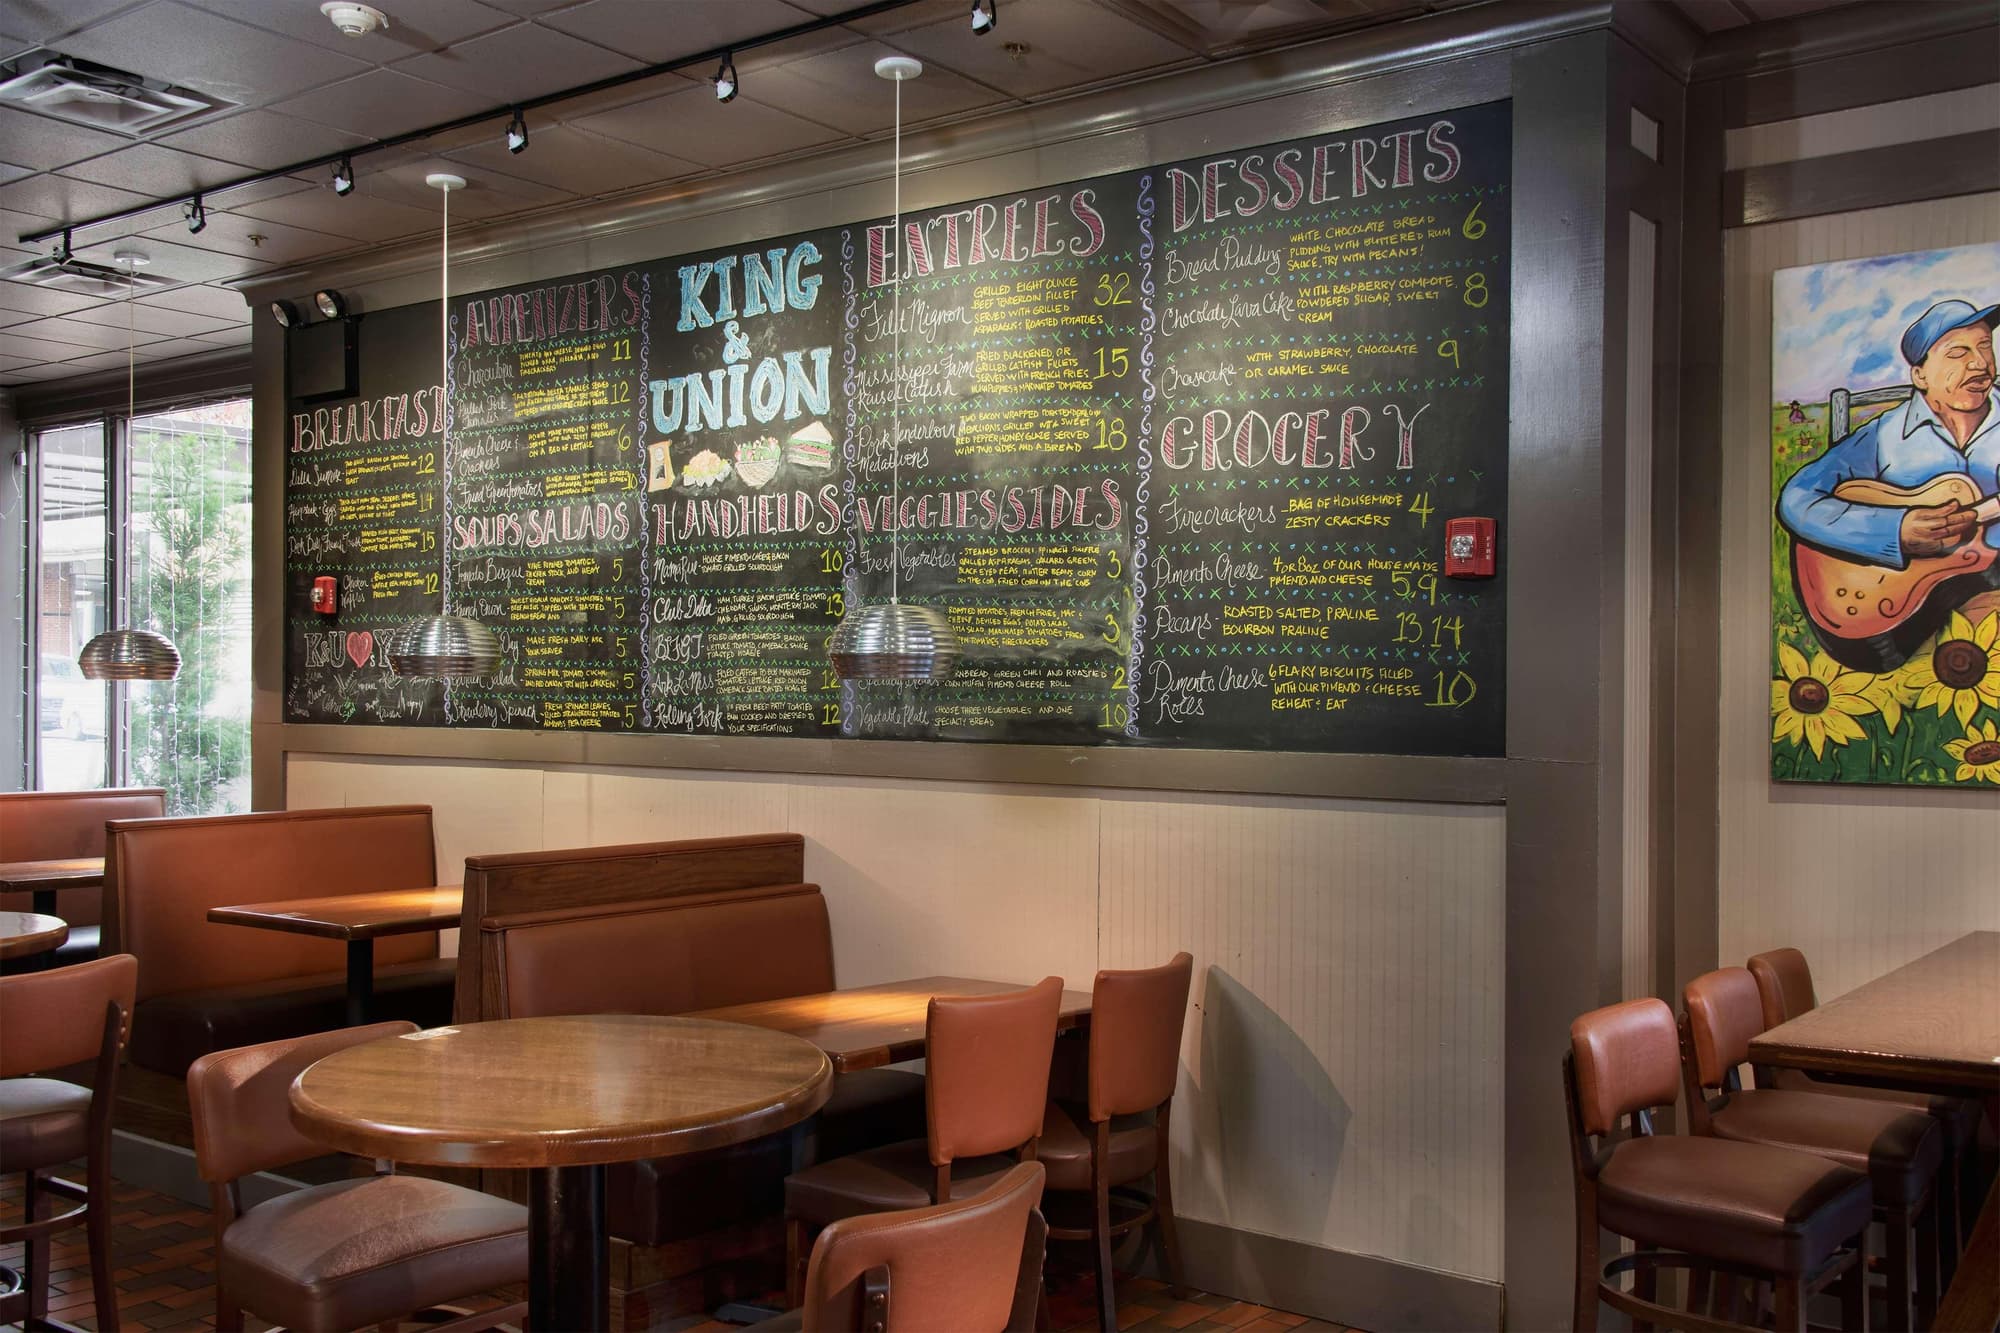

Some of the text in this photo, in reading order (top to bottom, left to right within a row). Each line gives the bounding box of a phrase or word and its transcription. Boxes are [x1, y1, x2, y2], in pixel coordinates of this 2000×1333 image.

[1166, 120, 1461, 233] DESSERTS
[1289, 215, 1436, 244] WHITE CHOCOLATE BREAD
[1462, 201, 1487, 240] 6
[865, 189, 1106, 288] ENTREES
[1289, 227, 1451, 259] PUDDING WITH RUM
[1164, 235, 1282, 286] Bread Pudding
[1322, 252, 1366, 267] TRY WITH
[676, 240, 823, 332] KING
[973, 278, 1046, 299] GRILLED EIGHT
[1045, 289, 1078, 301] FILLET
[1093, 272, 1133, 307] 32
[1298, 279, 1396, 298] WITH RASPBERRY
[1463, 271, 1489, 309] 8
[460, 270, 641, 349] APPETIZERS
[1262, 290, 1296, 322] Cake
[1296, 291, 1440, 309] POWDERED SWEET
[974, 304, 1070, 325] SERVED WITH GRILLED
[1025, 316, 1059, 331] ROASTED
[1298, 311, 1333, 323] CREAM
[610, 338, 632, 362] 11
[723, 320, 752, 365] &
[976, 349, 1001, 361] FRIED
[1246, 343, 1419, 363] WITH CHOCOLATE
[1437, 339, 1460, 369] 9
[1063, 369, 1089, 379] FRIES
[1092, 346, 1129, 380] 15
[1244, 363, 1350, 379] OR CARAMEL SAUCE
[610, 380, 631, 405] 12
[650, 345, 833, 435] UNION
[291, 386, 445, 453] BREAKFAST
[616, 423, 632, 451] 6
[1092, 417, 1128, 451] 18
[1161, 403, 1430, 471] GROCERY
[416, 452, 436, 475] 12
[418, 491, 434, 513] 14
[651, 484, 842, 545] HANDHELDS
[1408, 491, 1436, 529] 4
[452, 501, 630, 550] SOUPS/SALADS
[1158, 496, 1277, 534] Firecrackers
[1285, 513, 1391, 529] ZESTY CRACKERS
[421, 530, 436, 553] 15
[612, 558, 624, 583] 5
[820, 549, 843, 573] 10
[1106, 549, 1122, 579] 3
[1150, 553, 1264, 590] Pimento Cheese
[1337, 559, 1364, 571] OUR
[424, 572, 440, 595] 12
[1328, 575, 1374, 586] CHEESE
[613, 596, 625, 620] 5
[825, 593, 845, 617] 13
[1223, 605, 1380, 621] ROASTED PRALINE
[1102, 613, 1121, 644] 3
[1150, 604, 1213, 640] Pecans
[1222, 624, 1331, 640] BOURBON PRALINE
[615, 636, 628, 658] 5
[623, 672, 636, 690] 5
[1112, 666, 1130, 690] 2
[1144, 659, 1269, 705] Pimento Cheese
[1268, 663, 1414, 681] 6 FLAKY BISCUITS FILLED
[1274, 681, 1423, 696] WITH OUR CHEESE
[1424, 670, 1477, 710] 10
[624, 704, 638, 729] 5
[821, 703, 842, 726] 12
[1097, 703, 1127, 728] 10
[1271, 698, 1348, 712] REHEAT EAT
